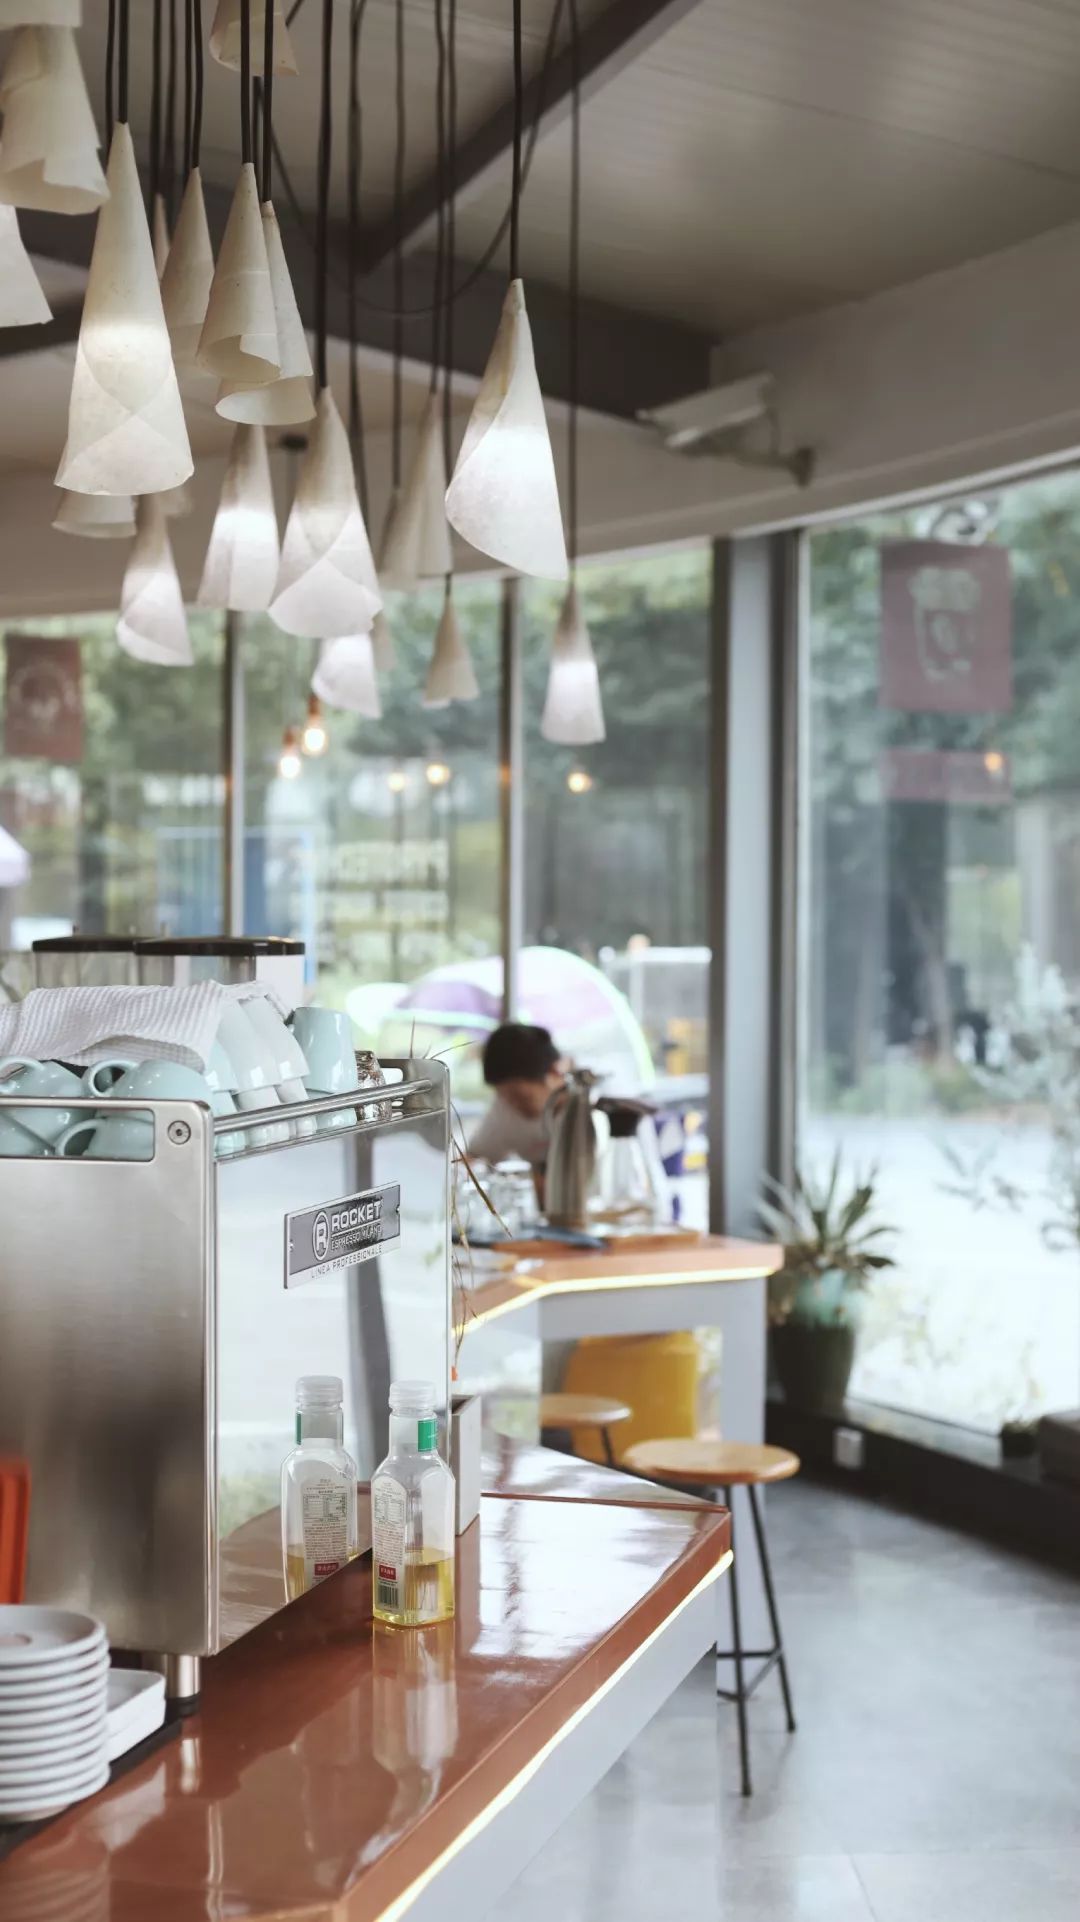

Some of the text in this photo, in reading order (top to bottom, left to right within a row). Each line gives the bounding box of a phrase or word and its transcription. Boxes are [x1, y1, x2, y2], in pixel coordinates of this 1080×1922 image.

[331, 1201, 381, 1232] ROCKET
[331, 1231, 361, 1250] ESPRESSO
[311, 1244, 383, 1279] LINEA PROFESSIONALE
